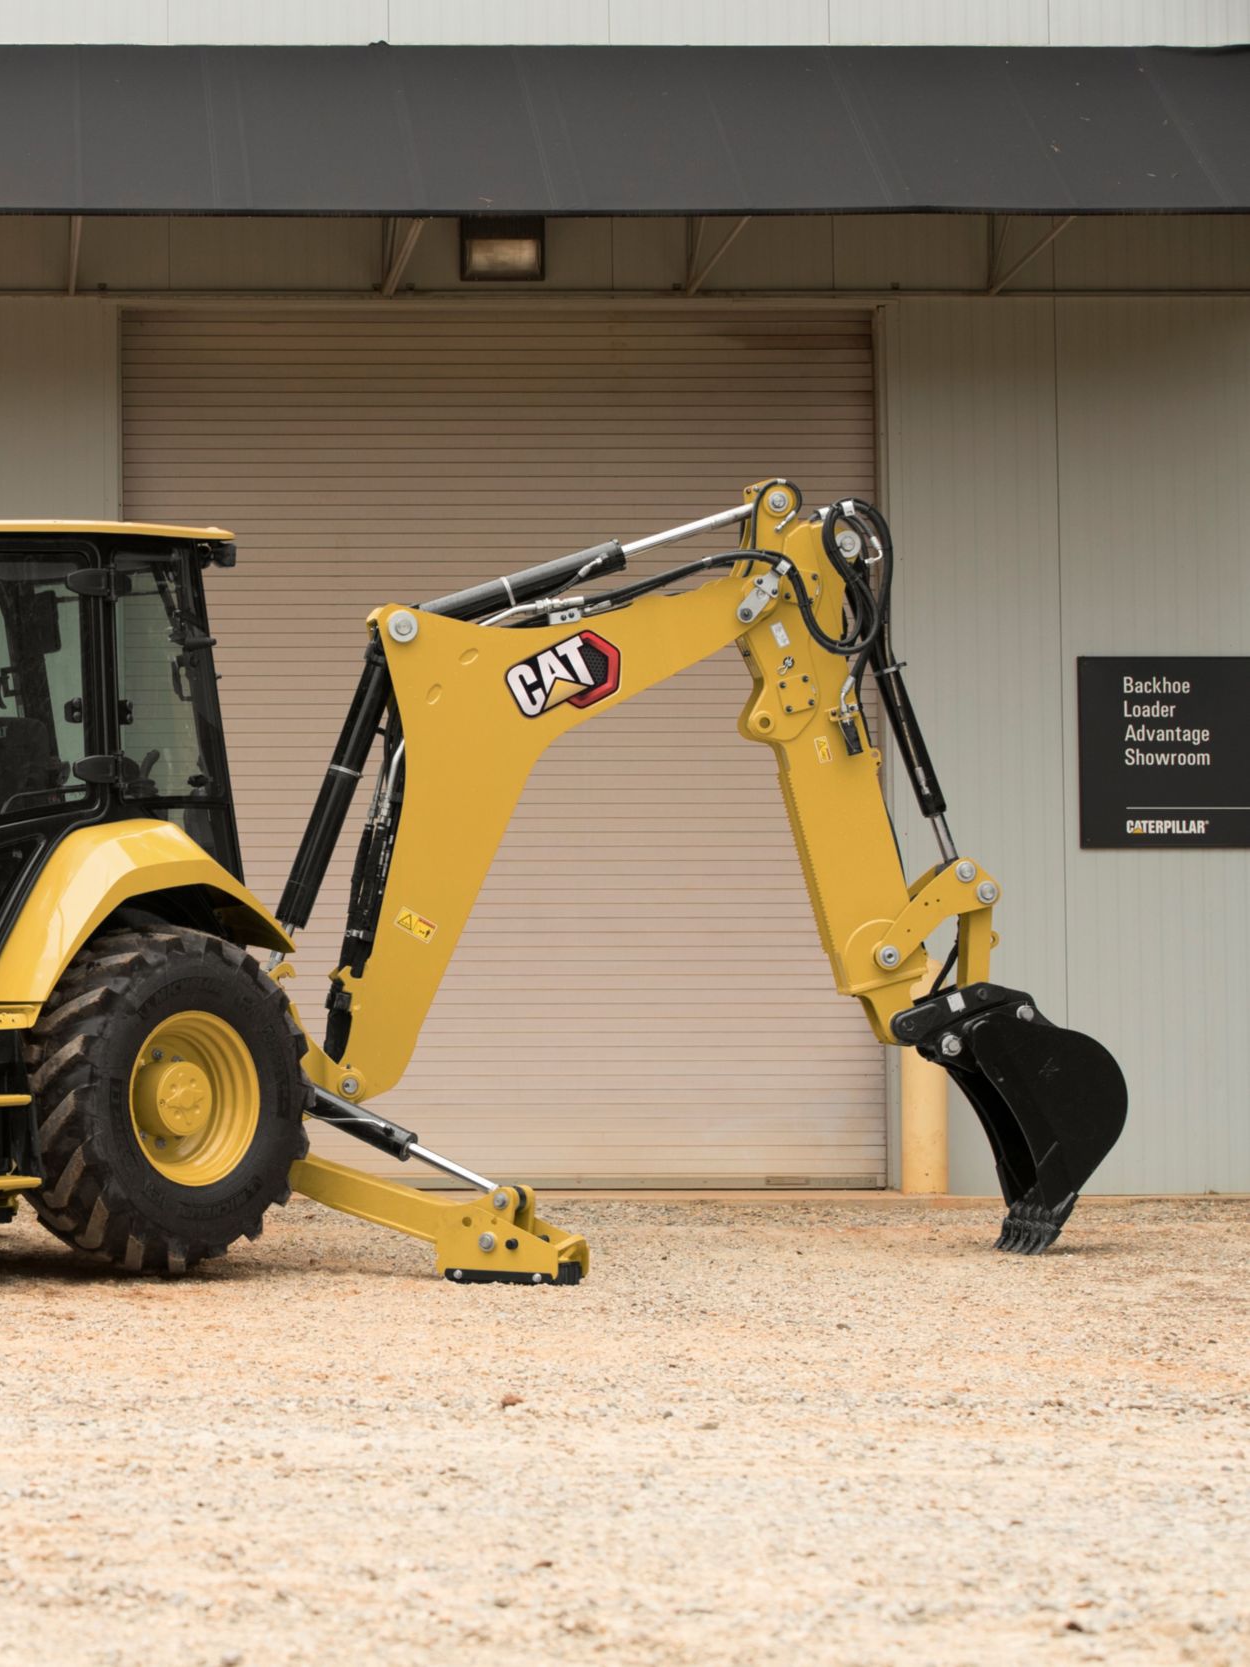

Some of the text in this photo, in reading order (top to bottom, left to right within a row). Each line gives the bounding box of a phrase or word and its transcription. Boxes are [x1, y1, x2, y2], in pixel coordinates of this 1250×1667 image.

[506, 634, 595, 716] CAT
[1123, 676, 1191, 694] Backhoe
[1124, 700, 1176, 717] Loader
[1124, 724, 1210, 745] Advantage
[1124, 748, 1211, 766] Showroom
